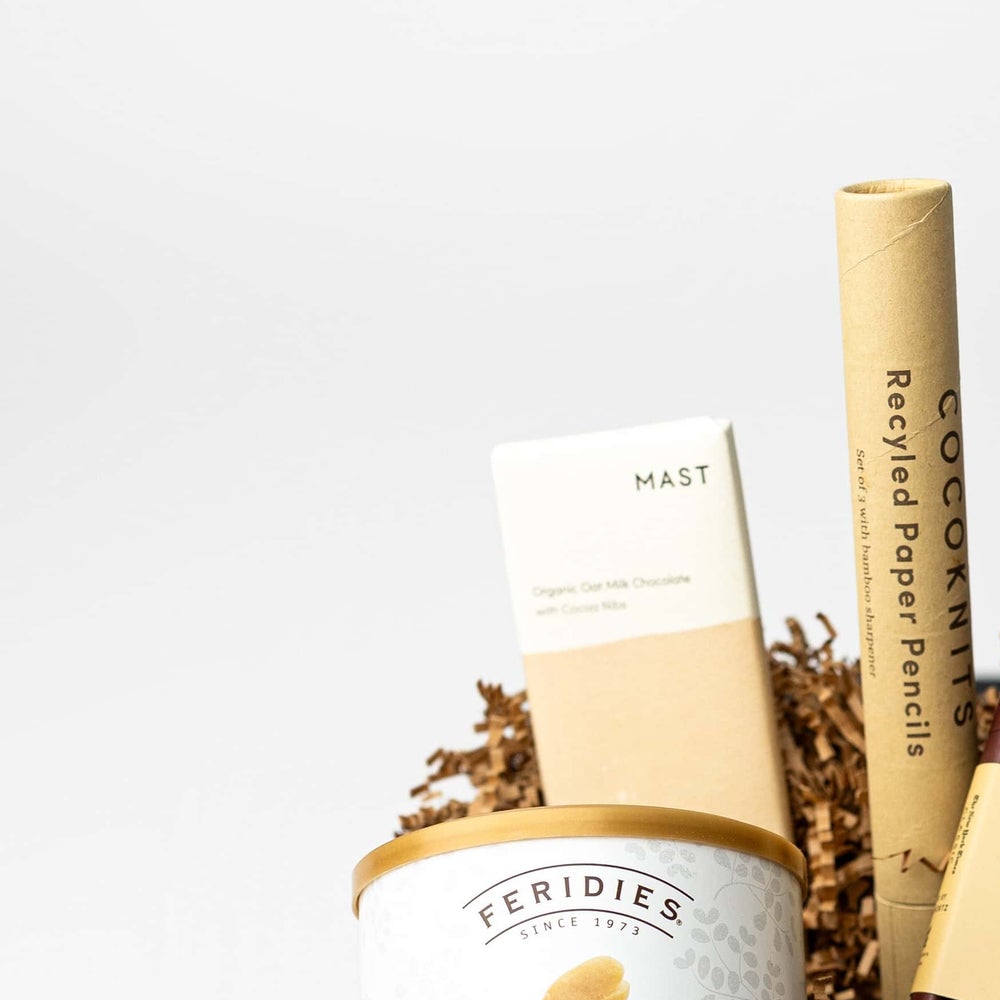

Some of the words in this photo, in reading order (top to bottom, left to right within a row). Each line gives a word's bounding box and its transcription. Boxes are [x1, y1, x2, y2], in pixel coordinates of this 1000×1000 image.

[882, 370, 918, 506] Recyled
[856, 448, 866, 472] Set
[635, 465, 709, 491] MAST
[858, 477, 867, 493] of
[857, 494, 866, 503] 3
[860, 507, 871, 540] with
[862, 543, 872, 604] bamboo
[890, 523, 919, 624] Paper
[938, 389, 974, 727] COCOKNITS
[533, 585, 577, 598] Organic
[606, 579, 629, 590] Milk
[633, 575, 691, 589] Chocolate
[865, 607, 877, 679] sharpener
[901, 639, 931, 757] Pencils
[520, 917, 577, 940] SINCE
[594, 918, 643, 935] 1973
